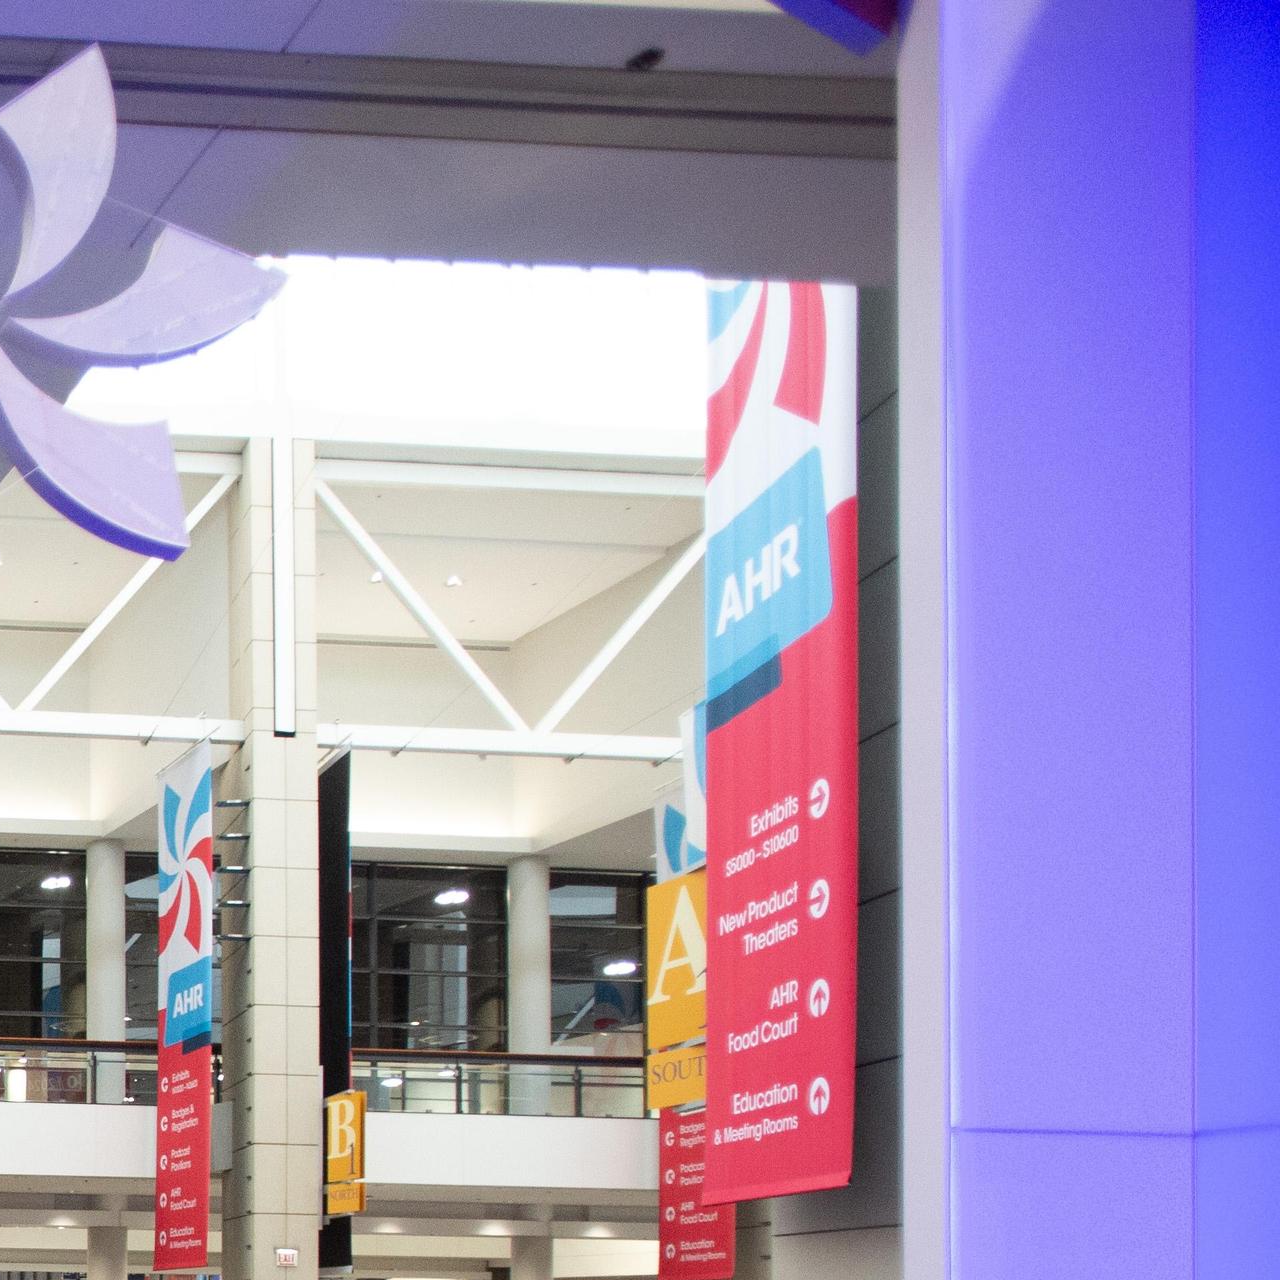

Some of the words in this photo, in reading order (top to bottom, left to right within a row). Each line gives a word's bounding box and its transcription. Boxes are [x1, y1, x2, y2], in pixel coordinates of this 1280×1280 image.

[715, 522, 801, 637] AHR
[750, 795, 799, 837] Exhibits
[725, 851, 755, 877] S5000
[762, 825, 799, 858] S10600
[719, 904, 747, 936] New
[748, 883, 798, 919] Product
[647, 885, 707, 1006] A
[744, 917, 798, 955] Theaters
[172, 983, 203, 1018] AHR
[770, 978, 799, 1009] AHR
[728, 1023, 760, 1053] Food
[761, 1015, 798, 1045] Court
[732, 1081, 798, 1115] Education
[327, 1099, 356, 1160] B
[714, 1129, 722, 1145] &
[723, 1119, 762, 1145] Meeting
[763, 1115, 799, 1138] Rooms
